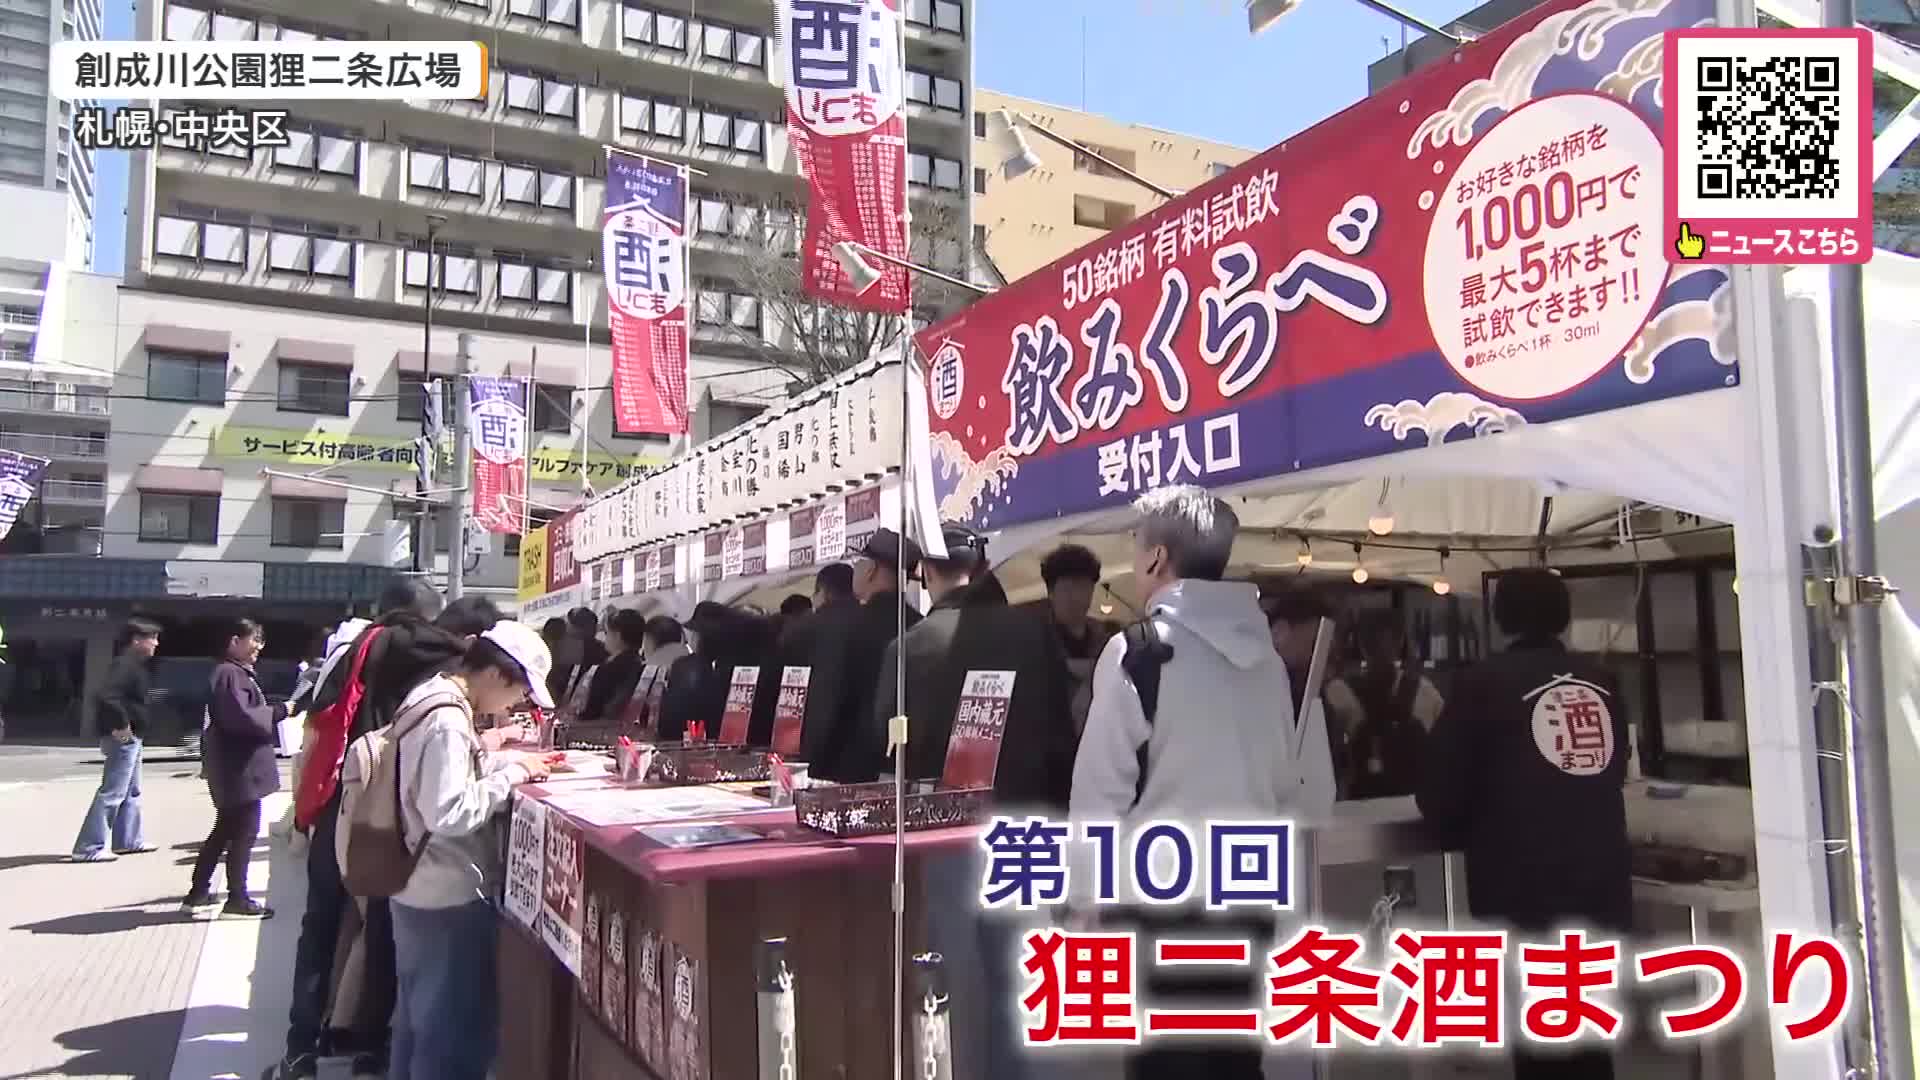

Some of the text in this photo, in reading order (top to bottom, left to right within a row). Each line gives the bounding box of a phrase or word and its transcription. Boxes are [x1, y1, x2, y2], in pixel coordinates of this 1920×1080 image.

[1457, 124, 1608, 203] お好きな銘柄を
[1062, 169, 1279, 310] 50銘柄 有料試飲
[1457, 163, 1642, 262] 1,000円で
[1459, 224, 1642, 309] 最大5杯まで
[1002, 195, 1389, 456] 飲みくらべ
[1564, 322, 1600, 344] 30ml
[936, 357, 957, 402] 酒
[243, 436, 416, 464] サービス付高齢者向
[1098, 414, 1241, 496] 受付入口
[1545, 701, 1606, 751] 酒
[1560, 750, 1606, 770] まつり
